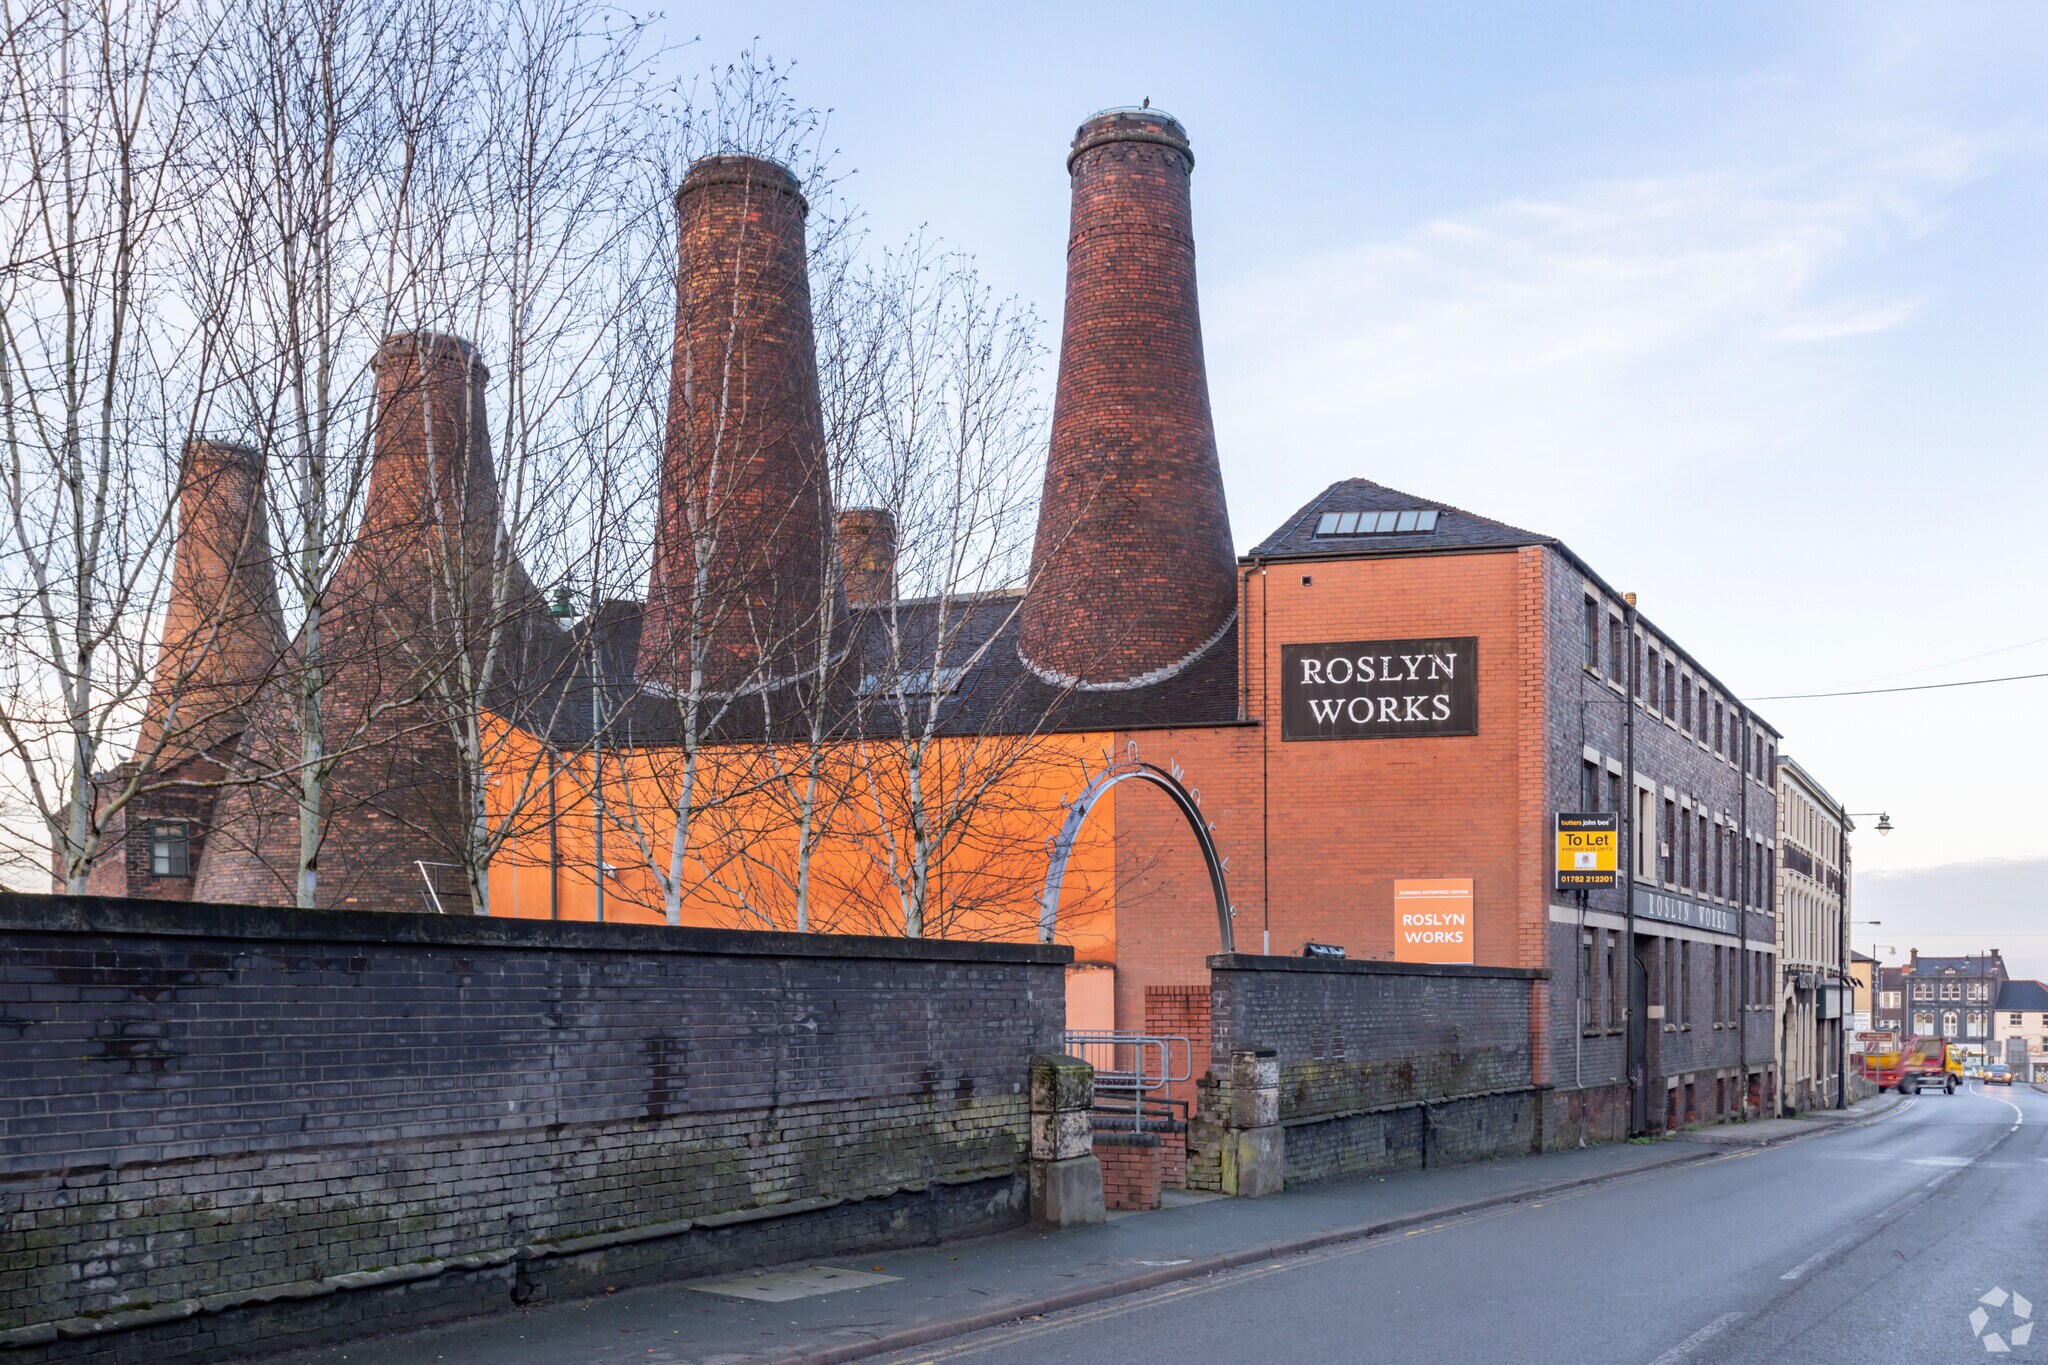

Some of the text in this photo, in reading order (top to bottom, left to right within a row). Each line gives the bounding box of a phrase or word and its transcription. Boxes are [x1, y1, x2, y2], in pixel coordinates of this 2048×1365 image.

[1300, 653, 1457, 684] ROSLYN
[1307, 694, 1451, 724] WORKS
[1583, 819, 1597, 827] john
[1565, 833, 1609, 846] To Let
[1648, 893, 1727, 930] ROSLYN WORKS
[1403, 913, 1465, 926] ROSLYN
[1404, 931, 1464, 944] WORKS
